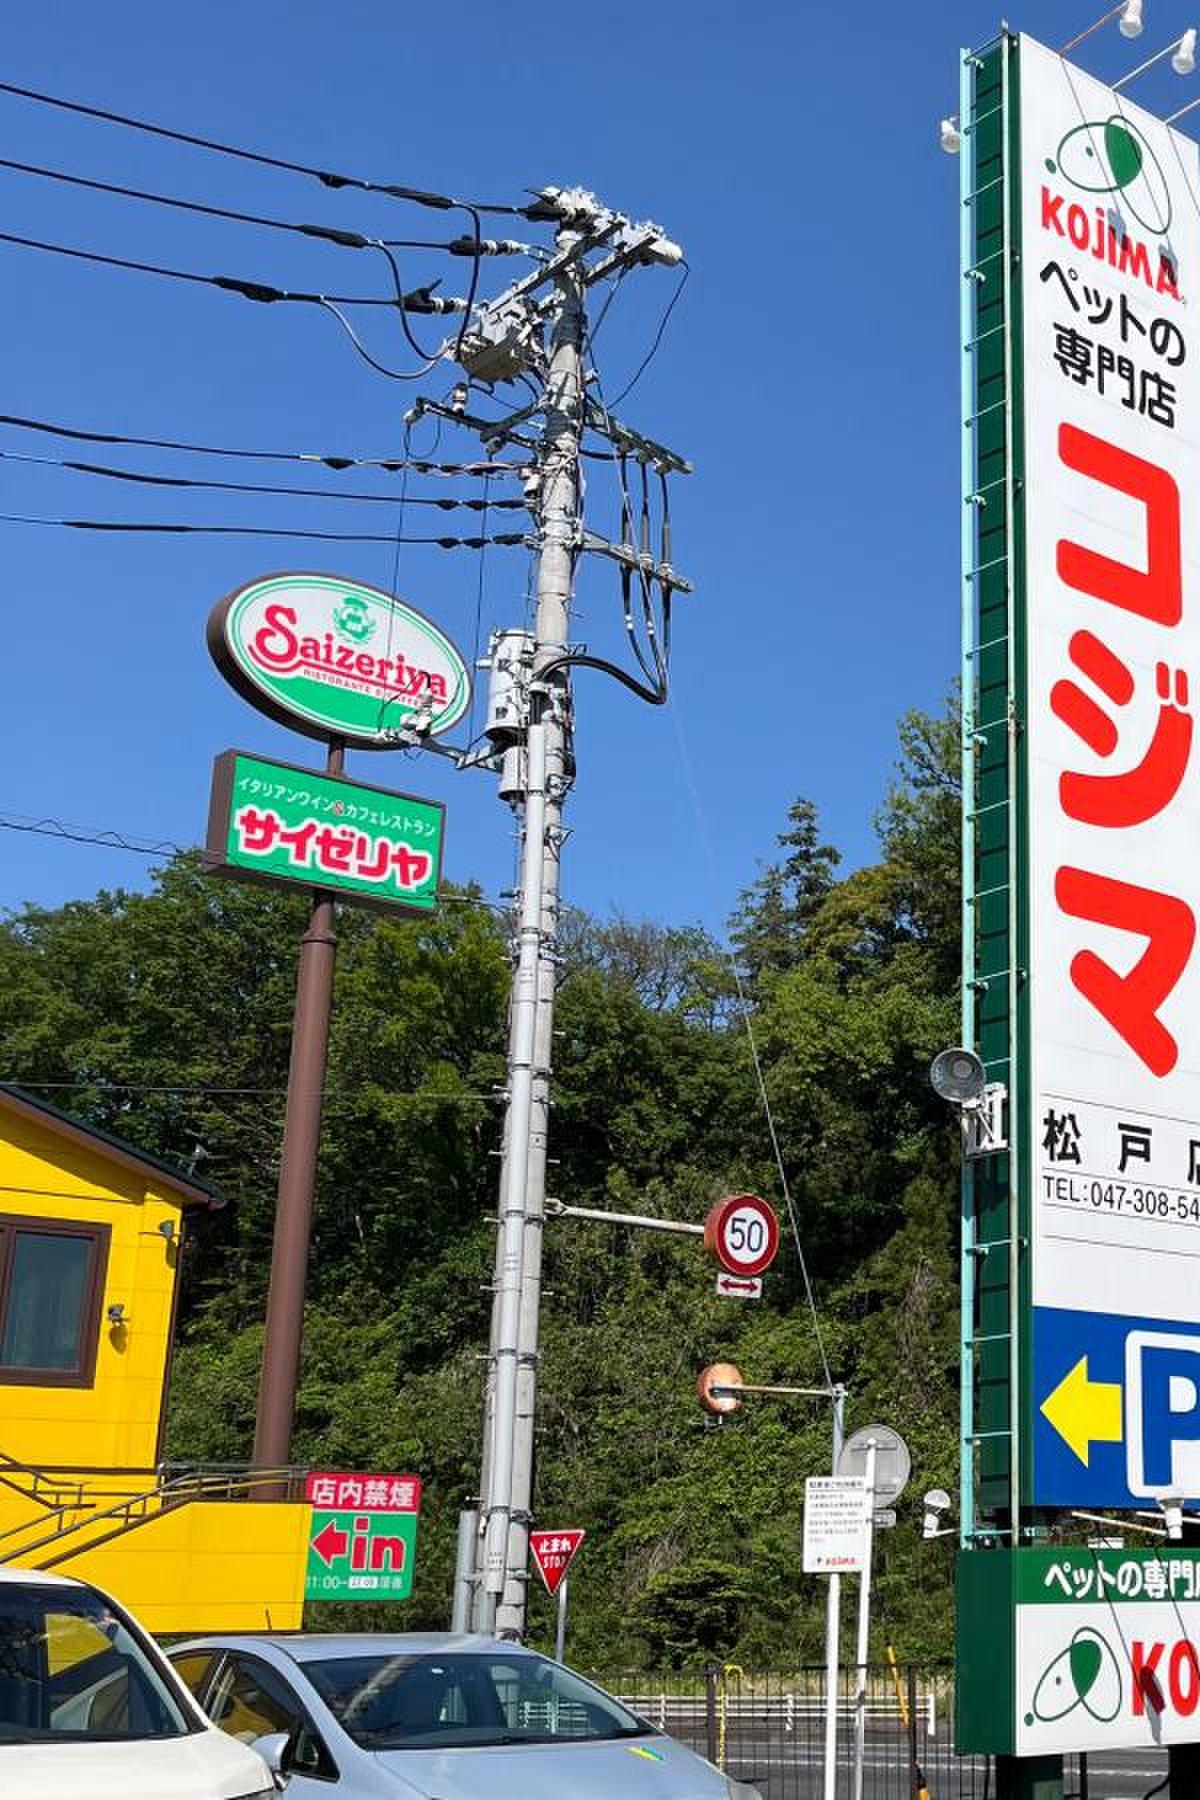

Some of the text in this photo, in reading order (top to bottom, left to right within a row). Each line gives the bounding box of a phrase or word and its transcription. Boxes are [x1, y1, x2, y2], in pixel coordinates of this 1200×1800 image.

[1040, 261, 1186, 367] ペットの
[1053, 322, 1176, 428] 専門店
[249, 604, 448, 701] Saizeriya
[1050, 422, 1196, 1078] コジマ
[239, 807, 429, 886] サイゼリヤ
[730, 1217, 763, 1252] 50
[312, 1478, 415, 1506] 店内禁煙
[351, 1515, 406, 1572] in
[539, 1537, 571, 1553] 止まれ
[543, 1555, 566, 1569] STOP
